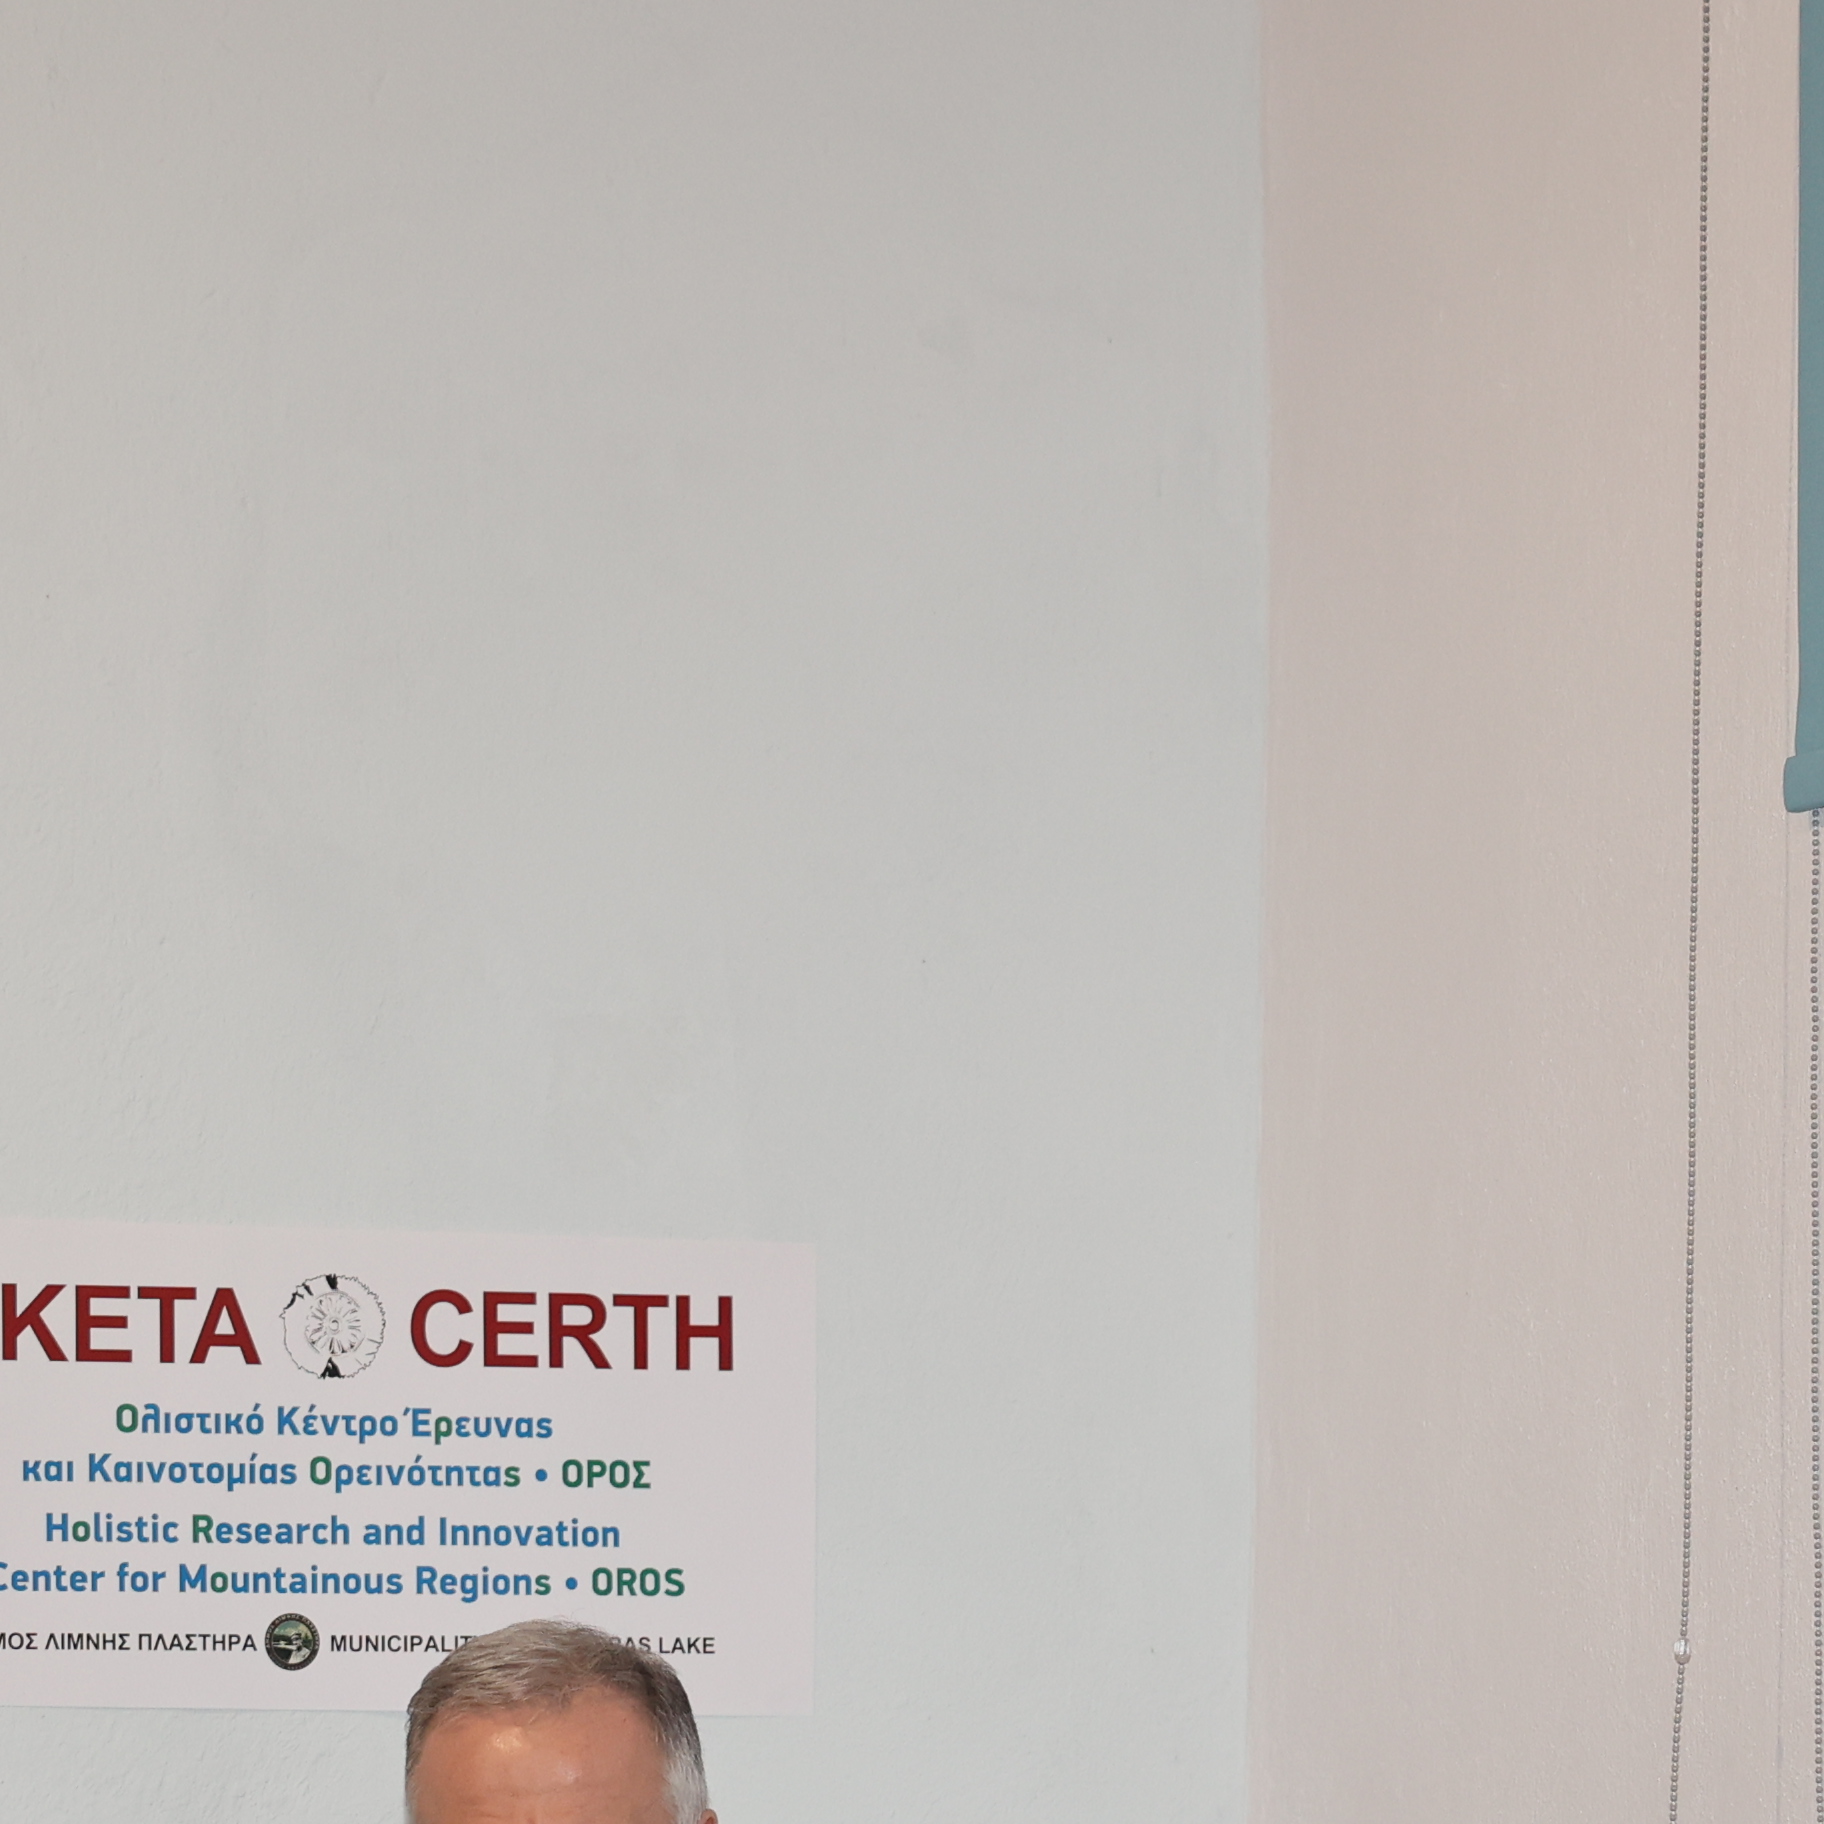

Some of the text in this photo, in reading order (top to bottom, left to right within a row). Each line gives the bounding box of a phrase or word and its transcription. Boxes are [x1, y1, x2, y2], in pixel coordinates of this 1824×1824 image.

[409, 1288, 734, 1372] CERTH
[115, 1402, 554, 1446] Ολιστικό Κέντρο Έρευνας
[22, 1452, 652, 1494] και Καινοτομίας Ορεινότητας ΟΡΟΣ
[45, 1511, 620, 1548] Holistic Research and Innovation
[116, 1561, 167, 1593] for
[178, 1563, 404, 1596] Mountainous
[415, 1565, 552, 1604] Regions
[591, 1566, 686, 1598] OROS
[44, 1632, 131, 1651] ΛΙΜΝΗΣ
[138, 1633, 258, 1652] ΠΛΑΣΤΗΡΑ
[330, 1634, 477, 1653] MUNICIPALIT
[658, 1636, 716, 1655] LAKE
